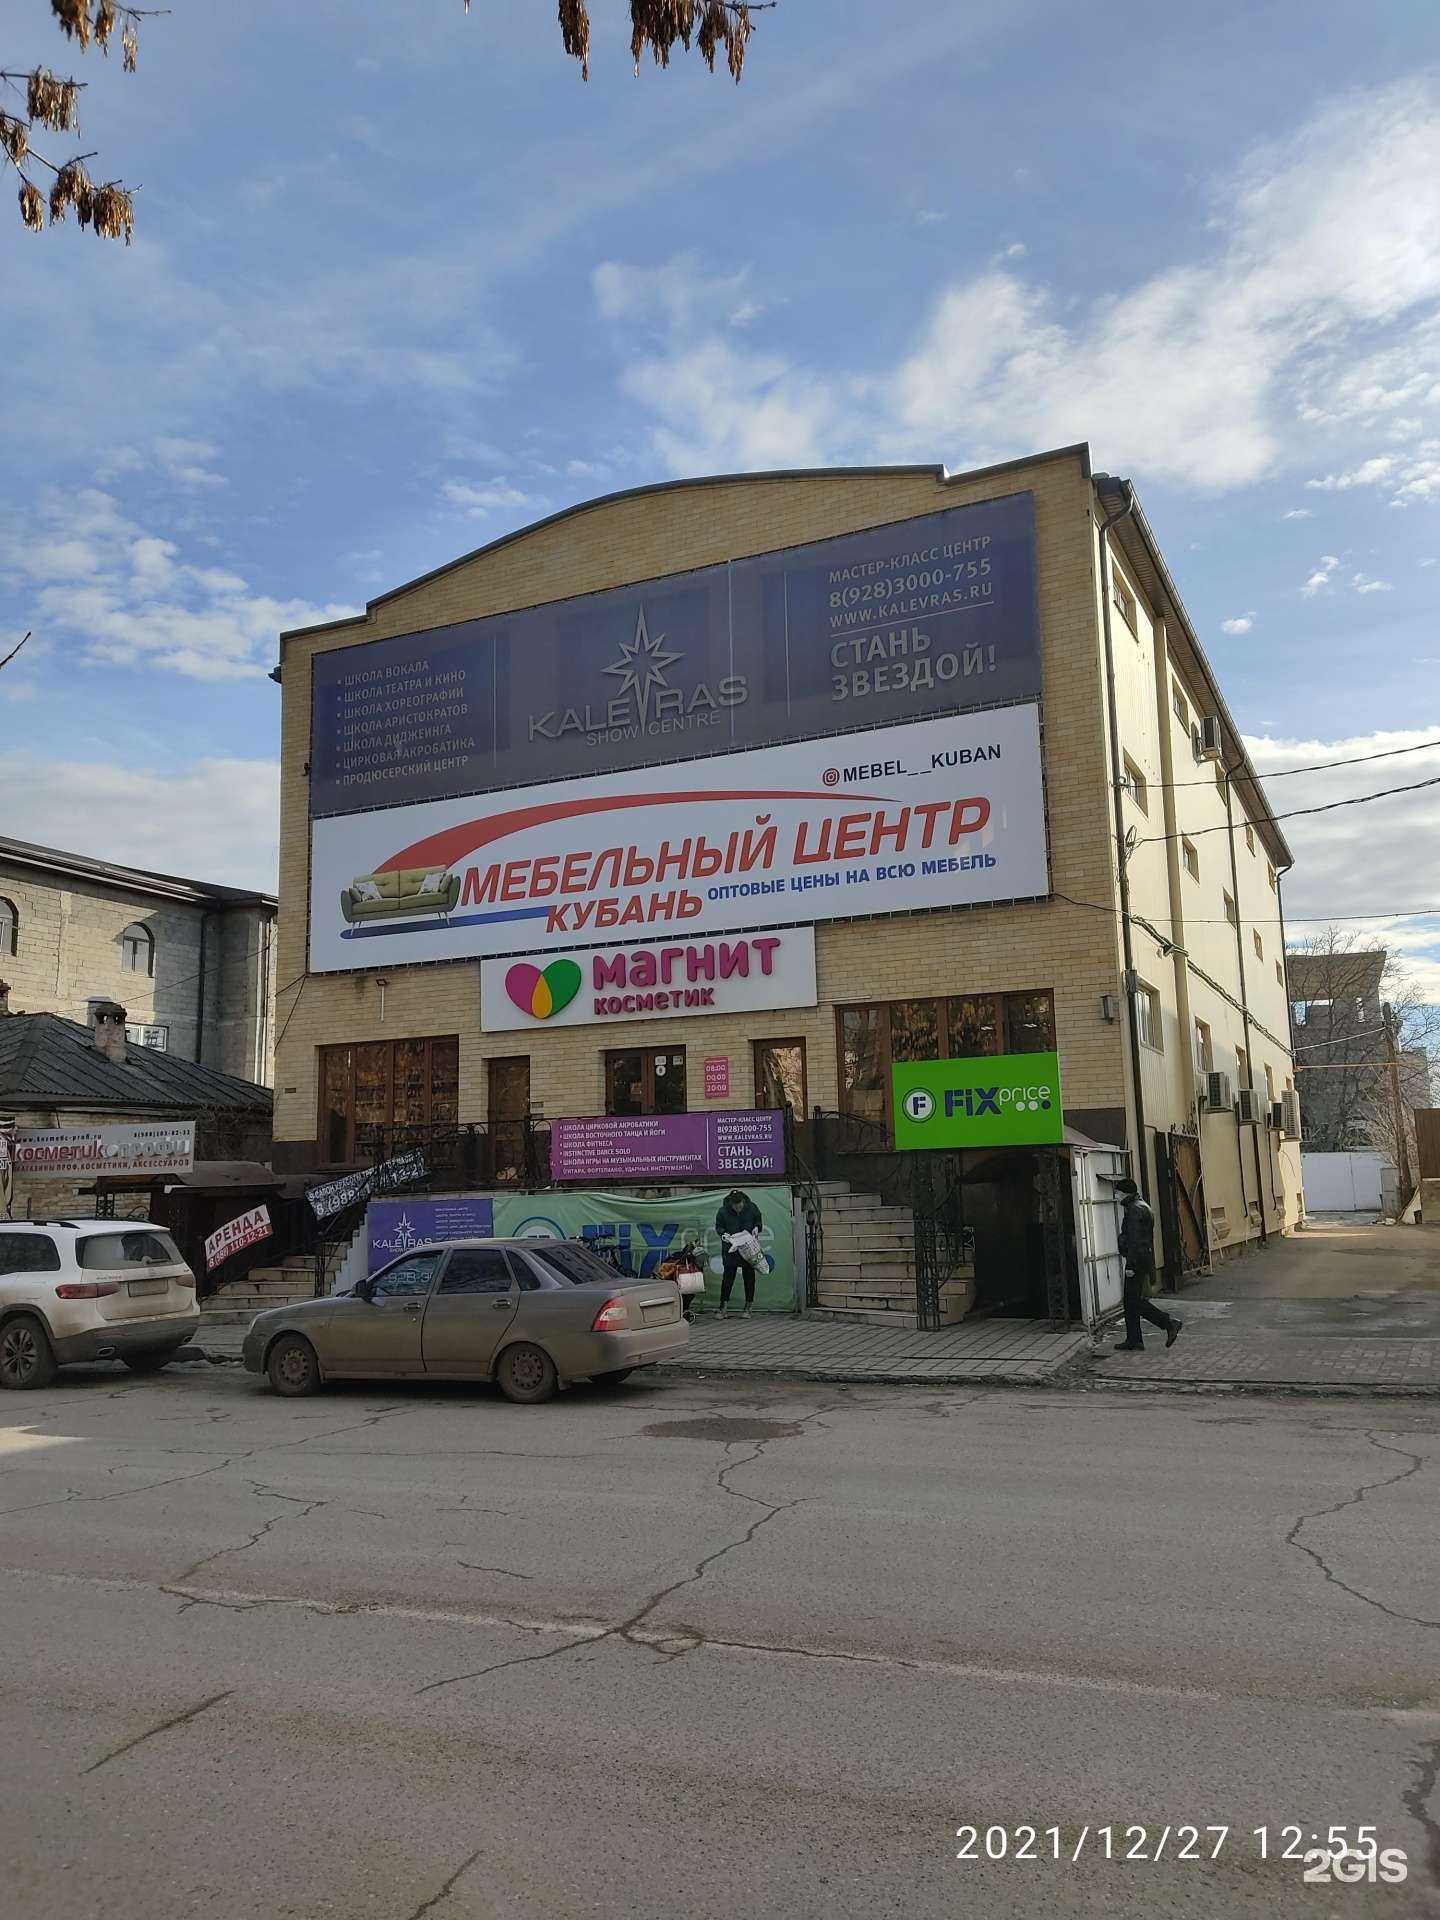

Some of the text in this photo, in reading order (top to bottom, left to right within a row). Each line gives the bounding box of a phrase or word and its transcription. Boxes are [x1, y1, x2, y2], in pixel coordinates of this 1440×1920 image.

[829, 536, 992, 584] МАСТЕР-КЛАСС ЦЕНТР
[830, 558, 991, 608] 8(928)3000-755
[830, 582, 993, 628] WWW.KALEVRAS.RU
[831, 627, 931, 668] СТАНЬ
[344, 660, 429, 686] ШКОЛА ВОКАЛА
[344, 687, 383, 703] ШКОЛА
[386, 679, 422, 695] ТЕАТРА
[435, 670, 466, 686] КИНО
[831, 642, 997, 701] ЗВЕЗДОЙ!
[344, 688, 464, 719] ШКОЛА ХОРЕОГРАФИИ
[344, 703, 468, 736] ШКОЛА АРИСТОКРАТОВ
[343, 737, 383, 752] ШКОЛА
[586, 710, 722, 746] SHOW CENTRE
[343, 736, 476, 770] ЦИРКОВАЯ АКРОБАТИКА
[343, 755, 469, 786] ПРОДЮСЕРСКИЙ ЦЕНТР
[460, 797, 991, 906] МЕБЕЛЬНЫЙ ЦЕНТР
[546, 853, 997, 934] КУБАНЬ ОПТОВЫЕ ЦЕНЫ НА ВСЮ МЕБЕЛЬ
[563, 1123, 585, 1132] ШКОЛА
[563, 1132, 585, 1140] ШКОЛА
[585, 1130, 623, 1139] ВОСТОЧНОГО
[624, 1130, 643, 1139] ТАНЦА
[717, 1125, 772, 1134] 8(928)3000-755
[563, 1140, 613, 1149] ШКОЛА ФИТНЕСА
[718, 1145, 753, 1157] СТАНЬ
[563, 1158, 585, 1166] ШКОЛА
[718, 1156, 774, 1171] ЗВЕЗДОЙ!
[208, 1211, 264, 1254] АРЕНДА
